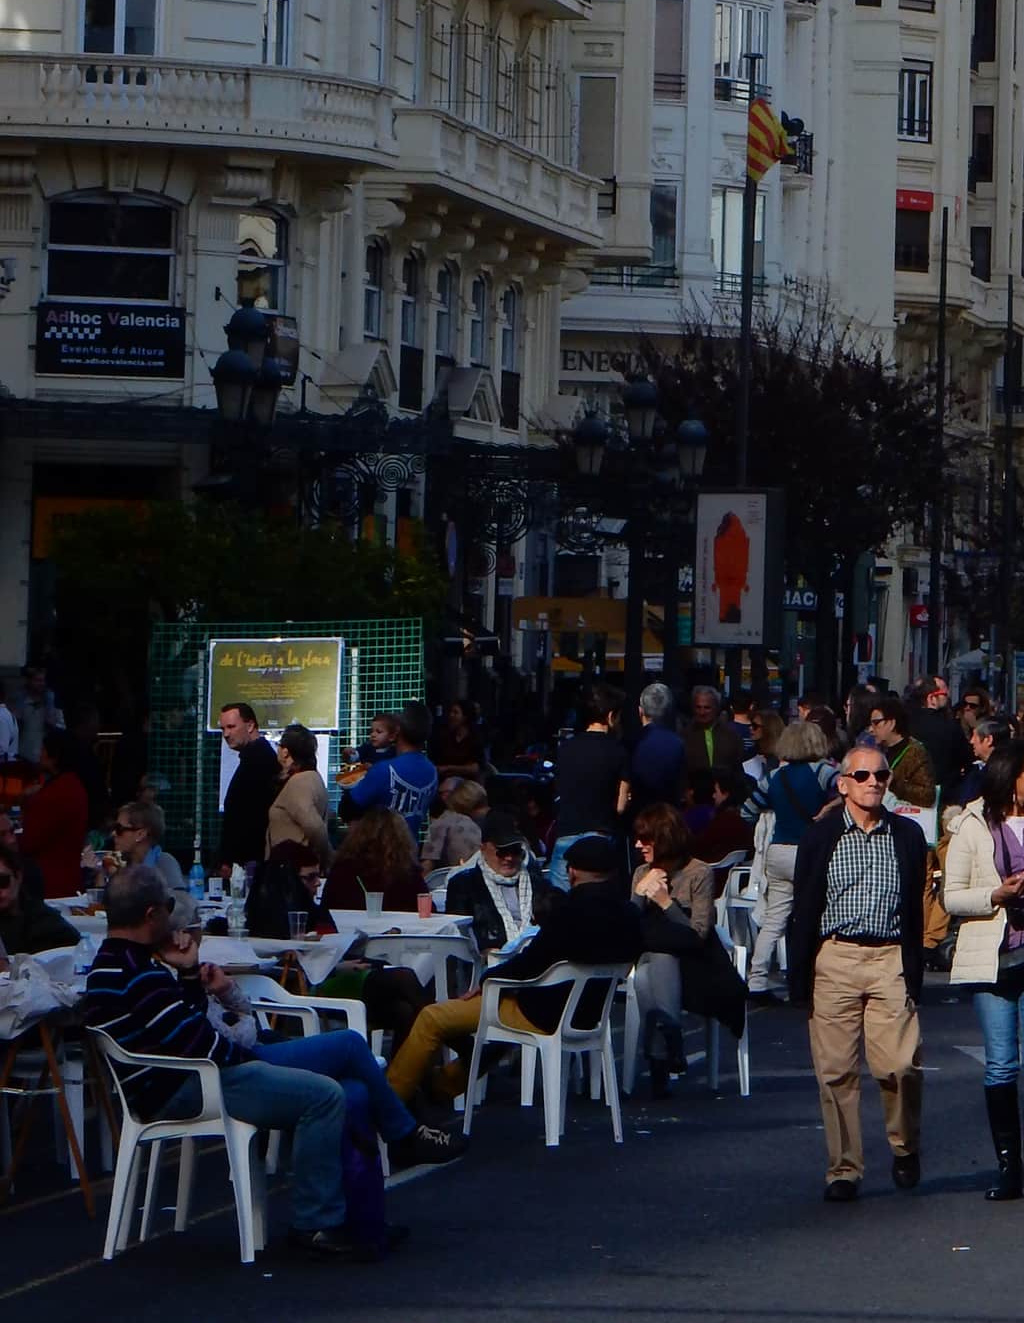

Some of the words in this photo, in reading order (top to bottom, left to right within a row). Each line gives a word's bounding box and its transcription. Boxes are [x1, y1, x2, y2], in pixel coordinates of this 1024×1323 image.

[46, 309, 102, 325] Adhoc
[106, 310, 181, 328] Valencia
[112, 345, 124, 356] de
[130, 346, 166, 357] Altura
